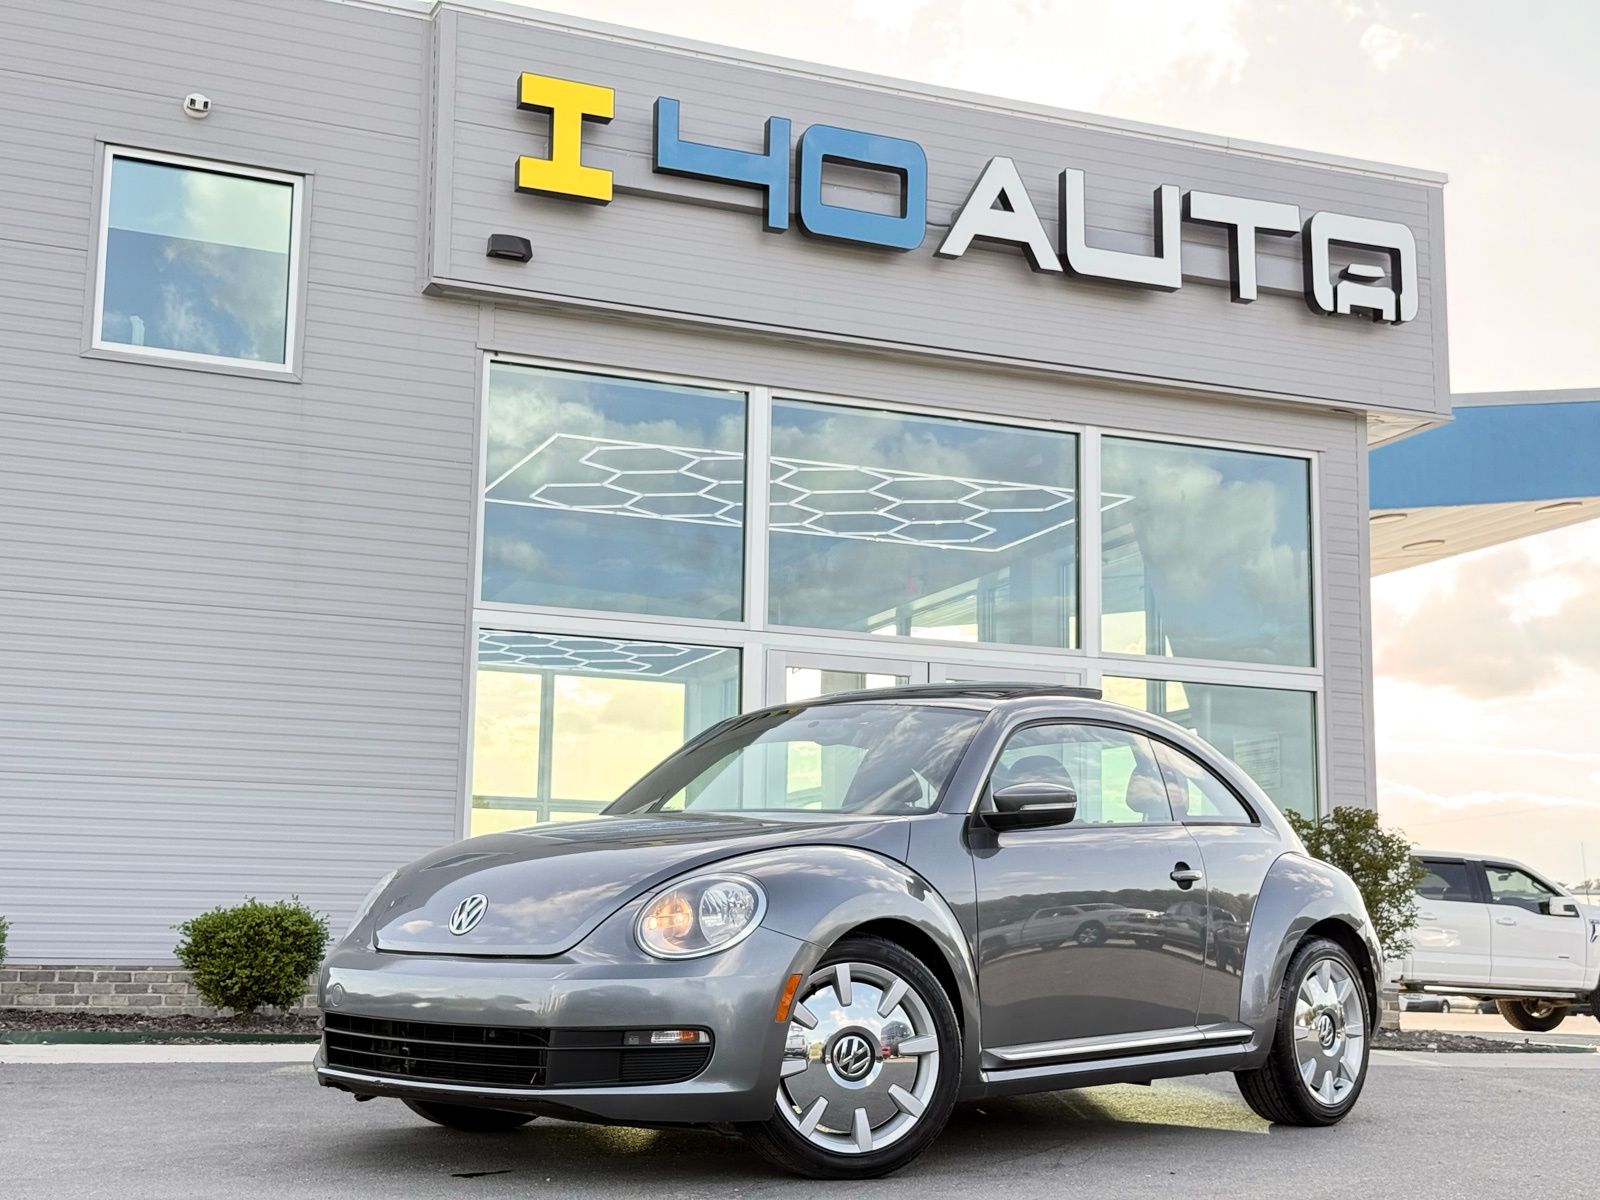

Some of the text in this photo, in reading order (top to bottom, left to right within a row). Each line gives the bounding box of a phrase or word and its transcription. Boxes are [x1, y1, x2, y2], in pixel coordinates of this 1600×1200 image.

[516, 72, 615, 206] I
[653, 96, 928, 251] 40
[449, 894, 488, 935] VW
[833, 1036, 871, 1077] VW
